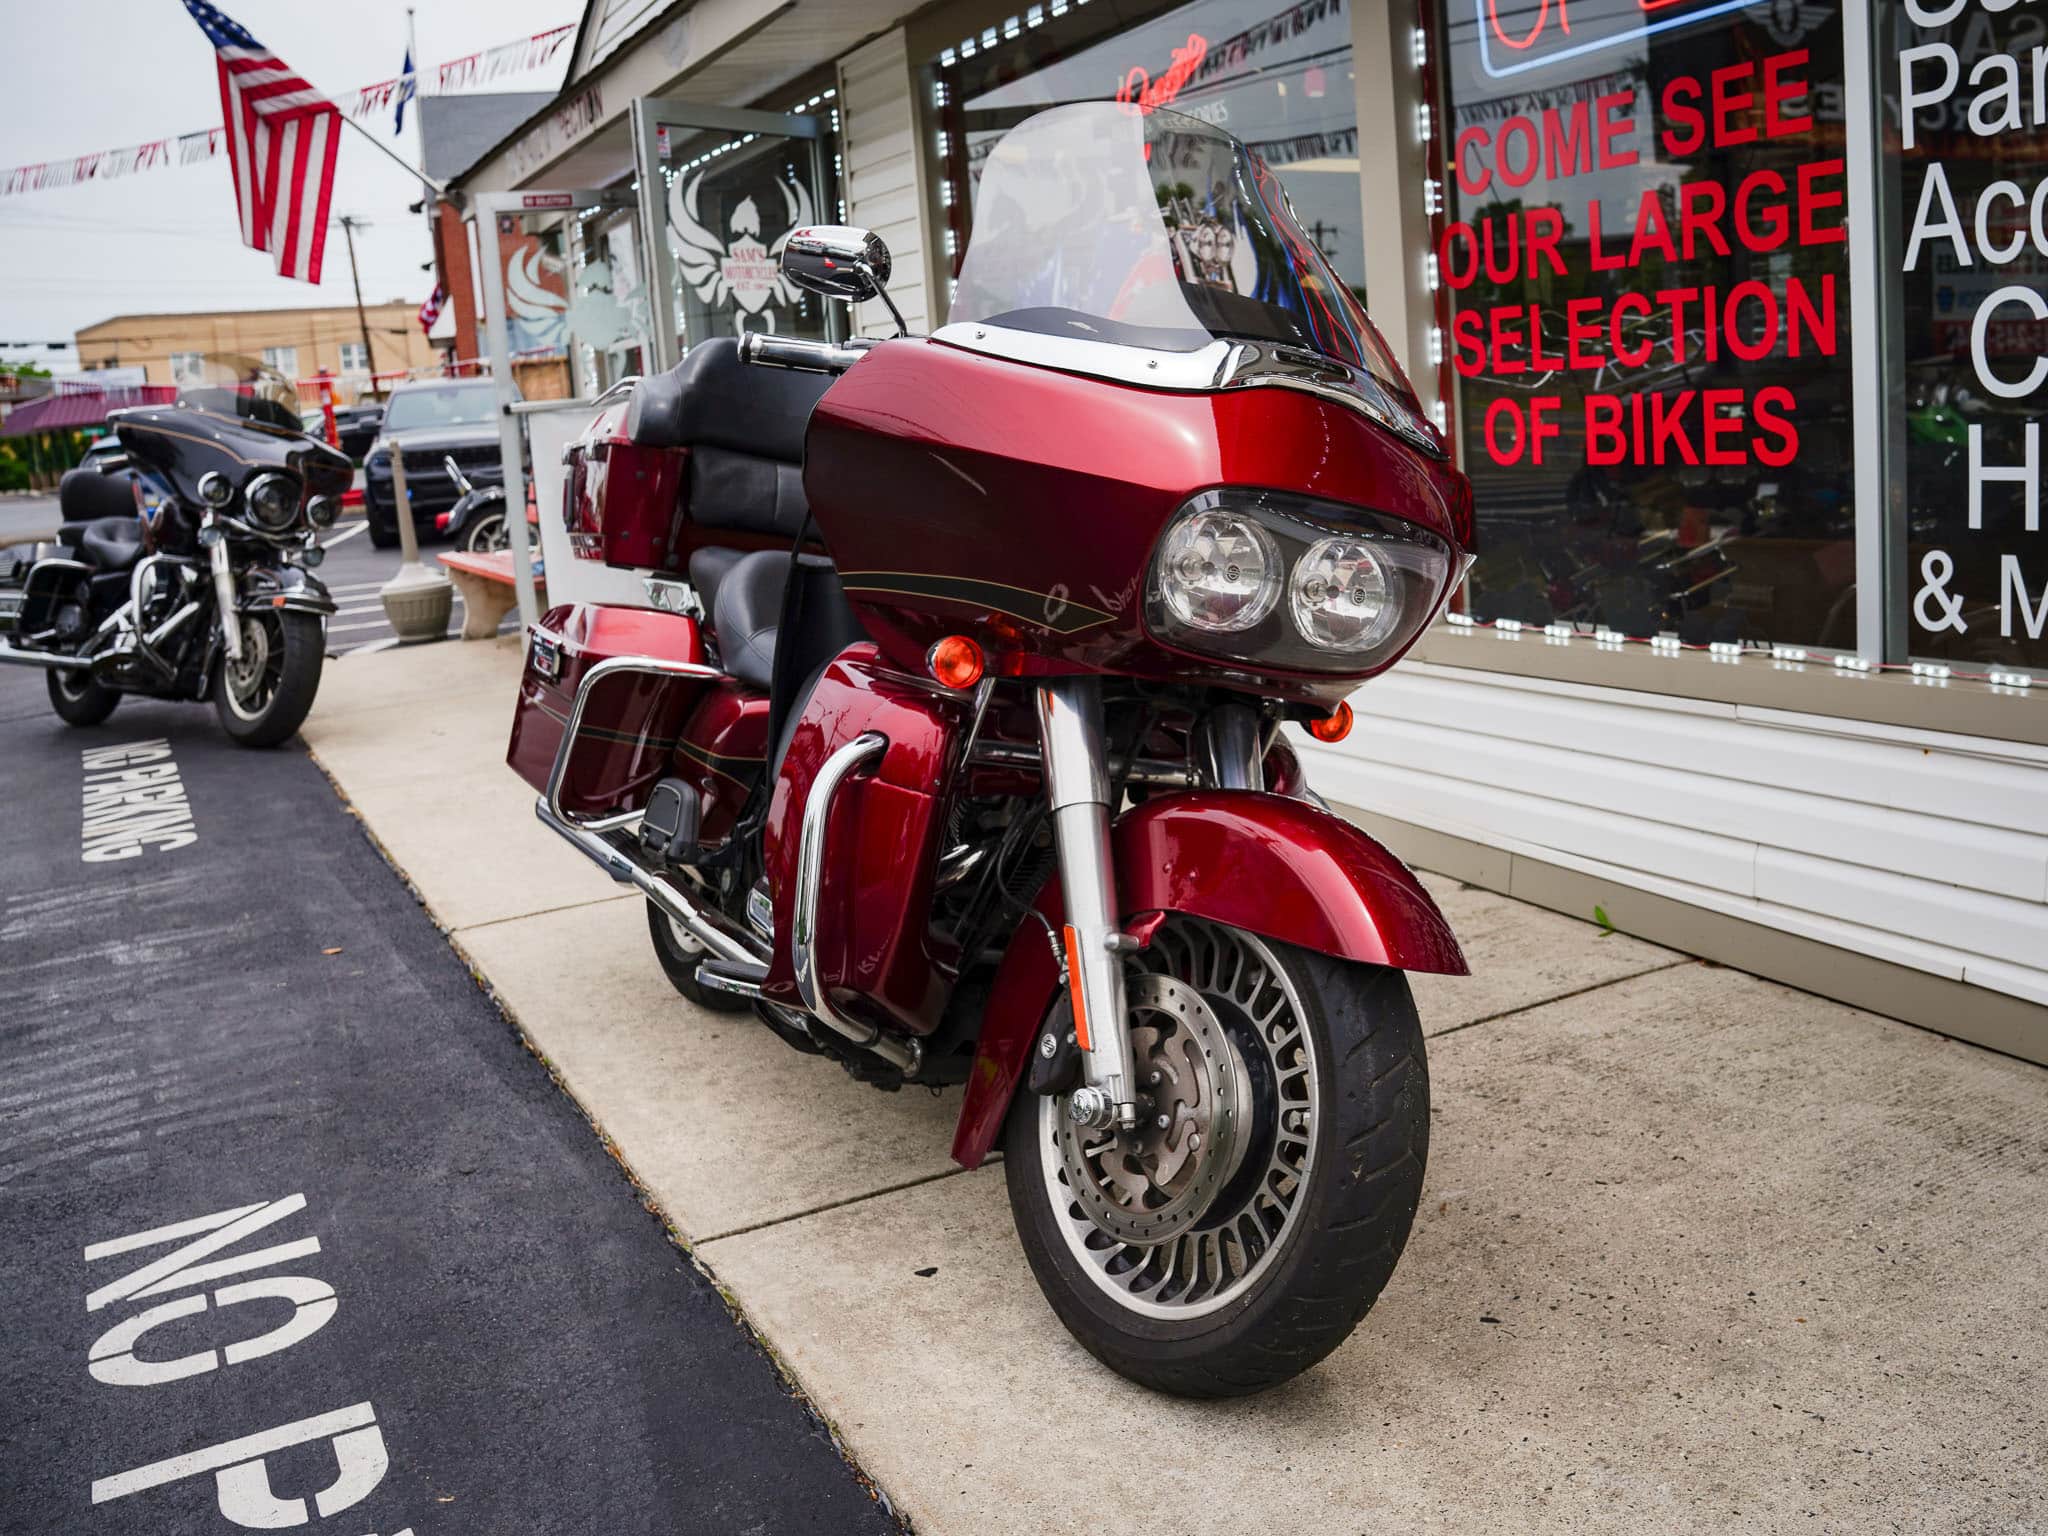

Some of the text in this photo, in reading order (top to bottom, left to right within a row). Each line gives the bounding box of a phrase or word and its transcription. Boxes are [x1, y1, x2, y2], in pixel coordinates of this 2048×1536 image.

[1454, 50, 1812, 195] COME SEE
[1440, 160, 1846, 288] OUR LARGE
[1453, 274, 1836, 377] SELECTION
[1484, 386, 1799, 467] OF BIKES
[1968, 423, 2039, 531] H
[1913, 550, 1967, 634] &
[85, 1193, 414, 1536] NO P
